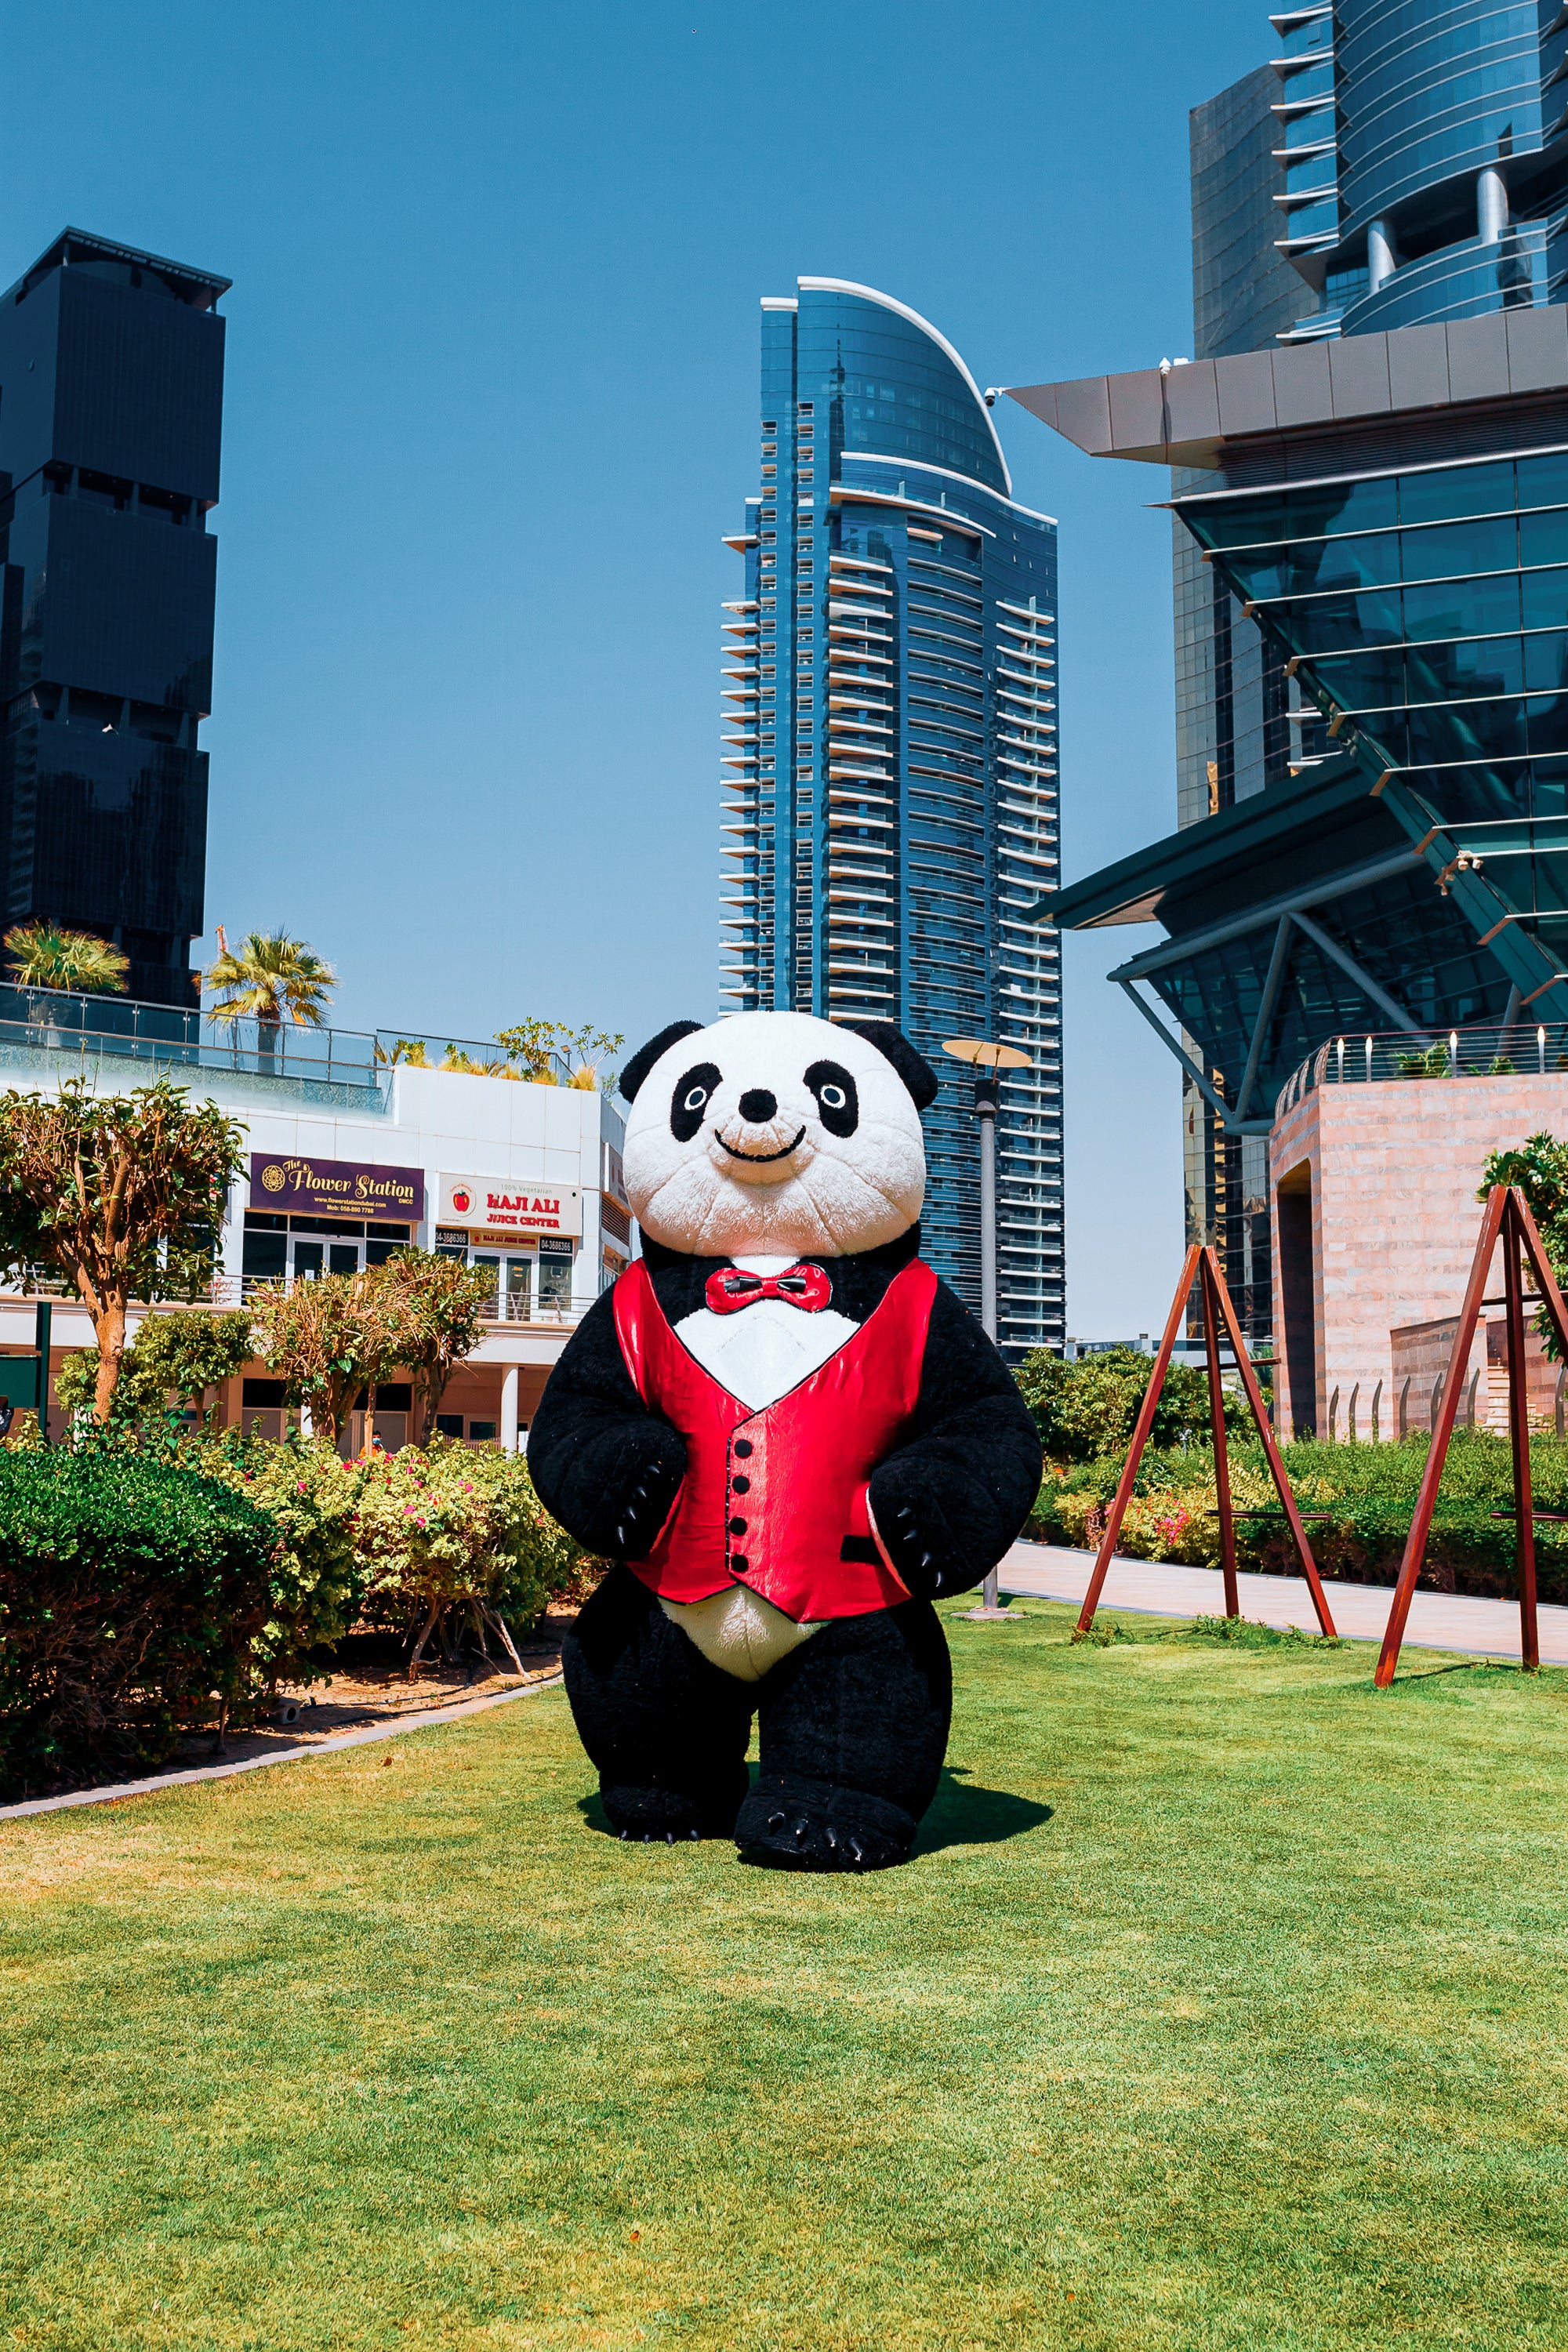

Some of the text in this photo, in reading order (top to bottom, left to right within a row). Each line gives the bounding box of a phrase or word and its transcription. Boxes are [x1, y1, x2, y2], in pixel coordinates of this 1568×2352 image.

[283, 1160, 300, 1172] The
[289, 1163, 414, 1199] Flower Station
[314, 1197, 387, 1208] www.flowerstationdubai.com
[487, 1193, 560, 1214] HAJI ALI
[487, 1214, 560, 1229] JUICE CENTER
